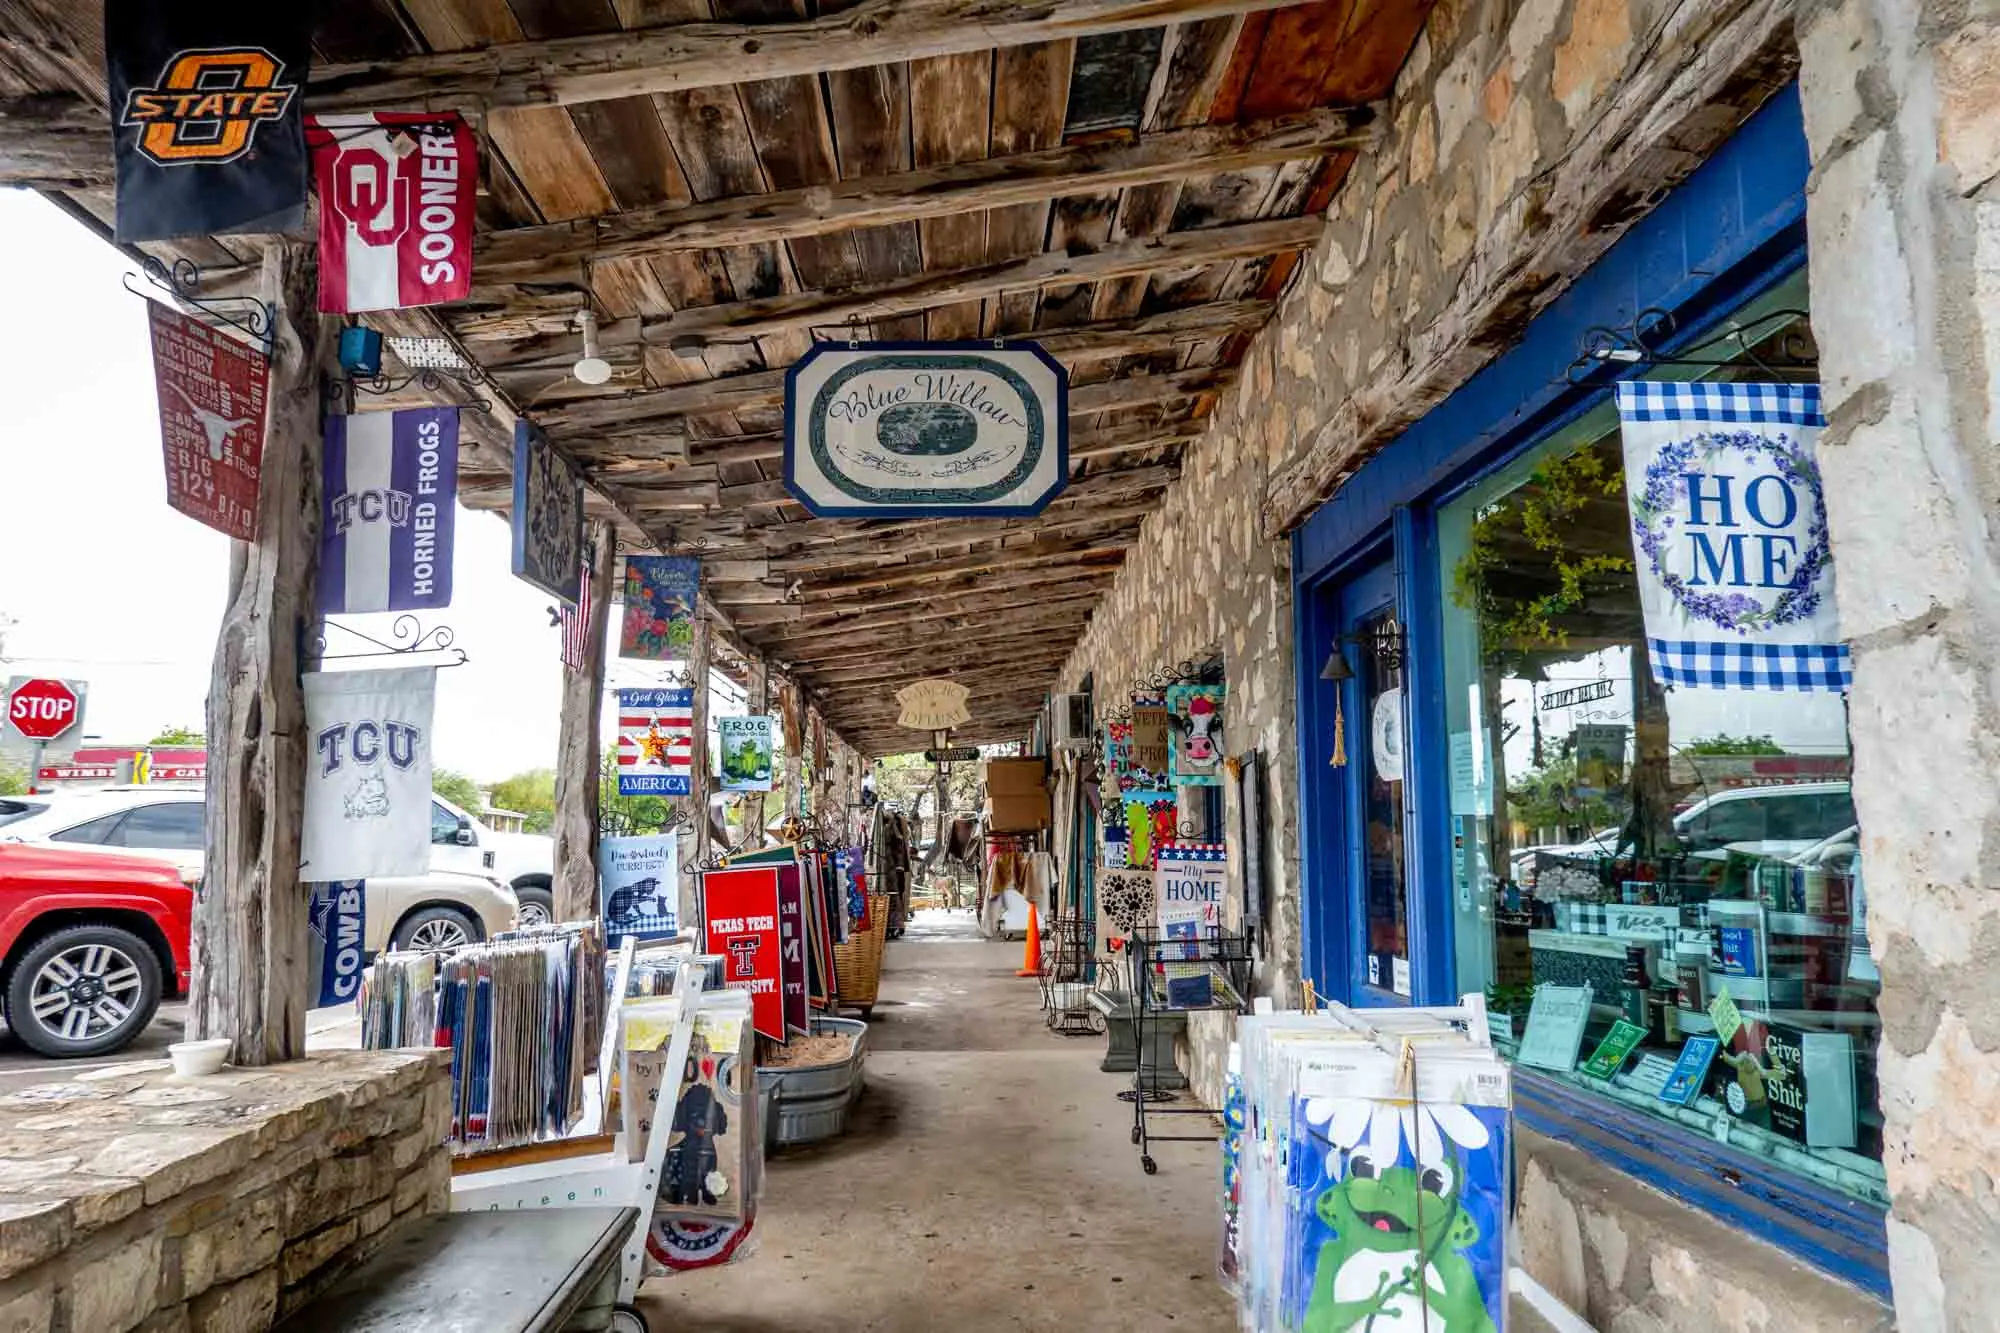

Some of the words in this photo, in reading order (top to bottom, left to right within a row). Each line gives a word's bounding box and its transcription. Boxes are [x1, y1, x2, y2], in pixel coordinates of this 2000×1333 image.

[131, 91, 289, 118] STATE
[829, 373, 911, 424] Blue
[914, 374, 1026, 428] Willow
[331, 489, 413, 536] TCU
[1679, 472, 1798, 529] HO
[413, 502, 437, 597] HORNED
[1684, 532, 1801, 590] ME
[12, 695, 73, 721] STOP
[629, 690, 651, 706] God
[317, 719, 421, 779] TCU
[621, 776, 687, 791] AMERICA
[1167, 880, 1221, 901] HOME
[711, 918, 745, 934] TEXAS
[746, 916, 774, 931] TECH
[1766, 1034, 1801, 1064] Give
[636, 1062, 651, 1078] by
[1767, 1077, 1804, 1111] Shit
